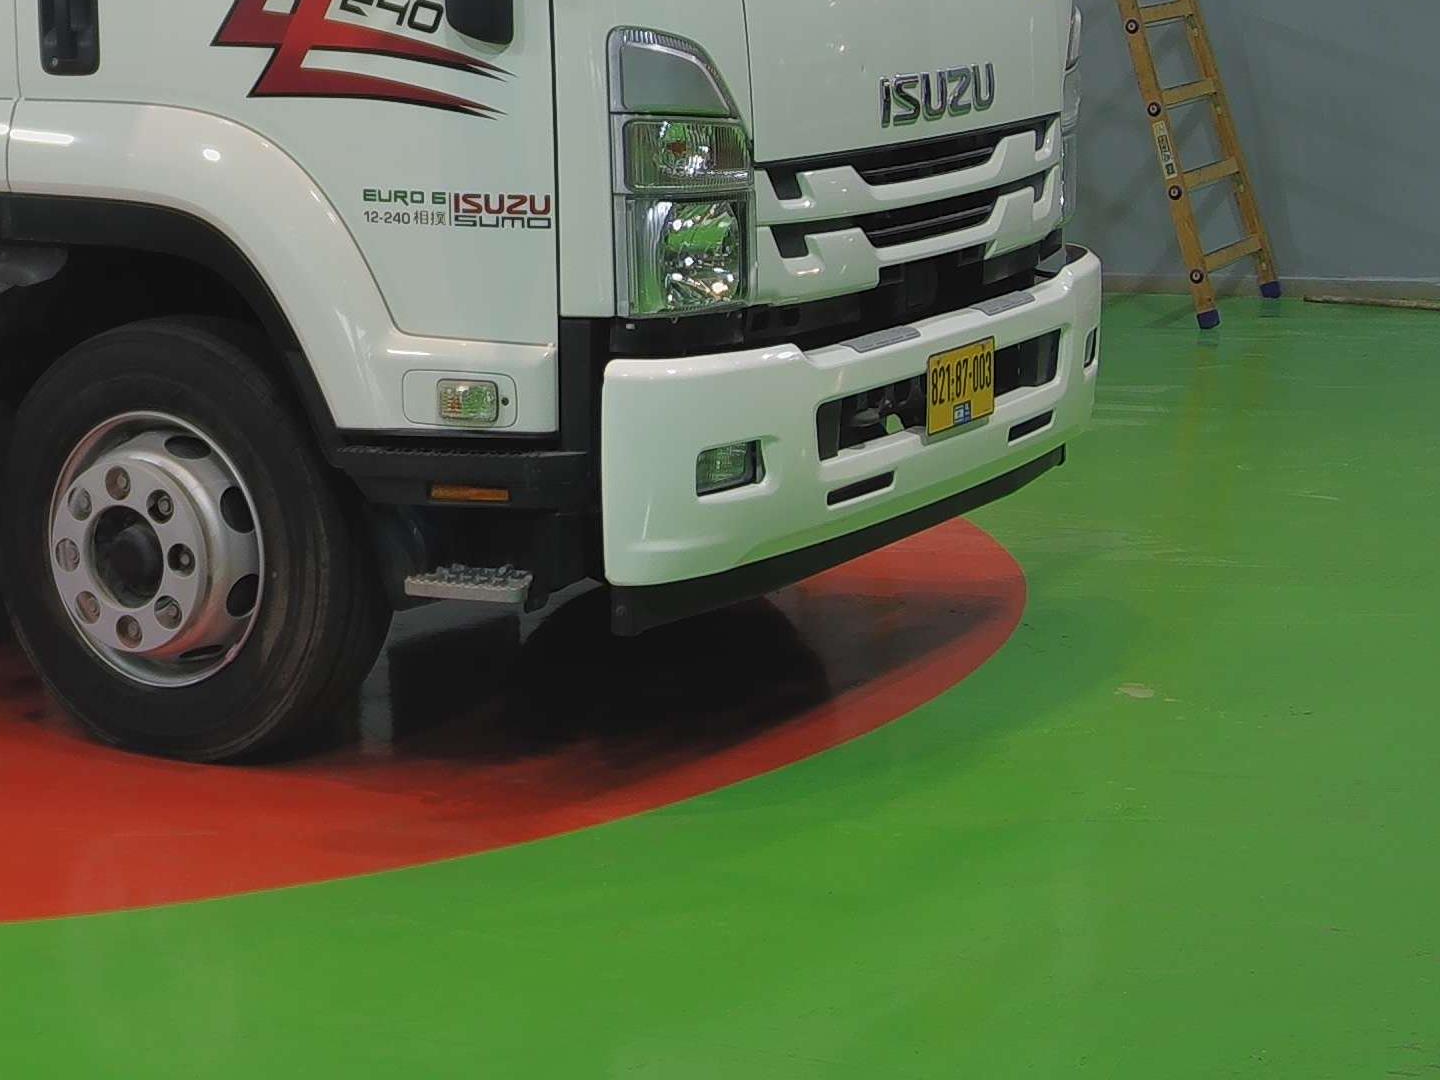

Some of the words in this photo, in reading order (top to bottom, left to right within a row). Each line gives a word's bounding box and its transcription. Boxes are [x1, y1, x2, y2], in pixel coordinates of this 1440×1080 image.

[880, 62, 995, 128] ISUZU
[362, 189, 425, 206] EURO
[431, 191, 447, 205] 6
[453, 193, 552, 215] ISUZU
[363, 210, 411, 225] 12-240
[454, 215, 552, 229] SUMO
